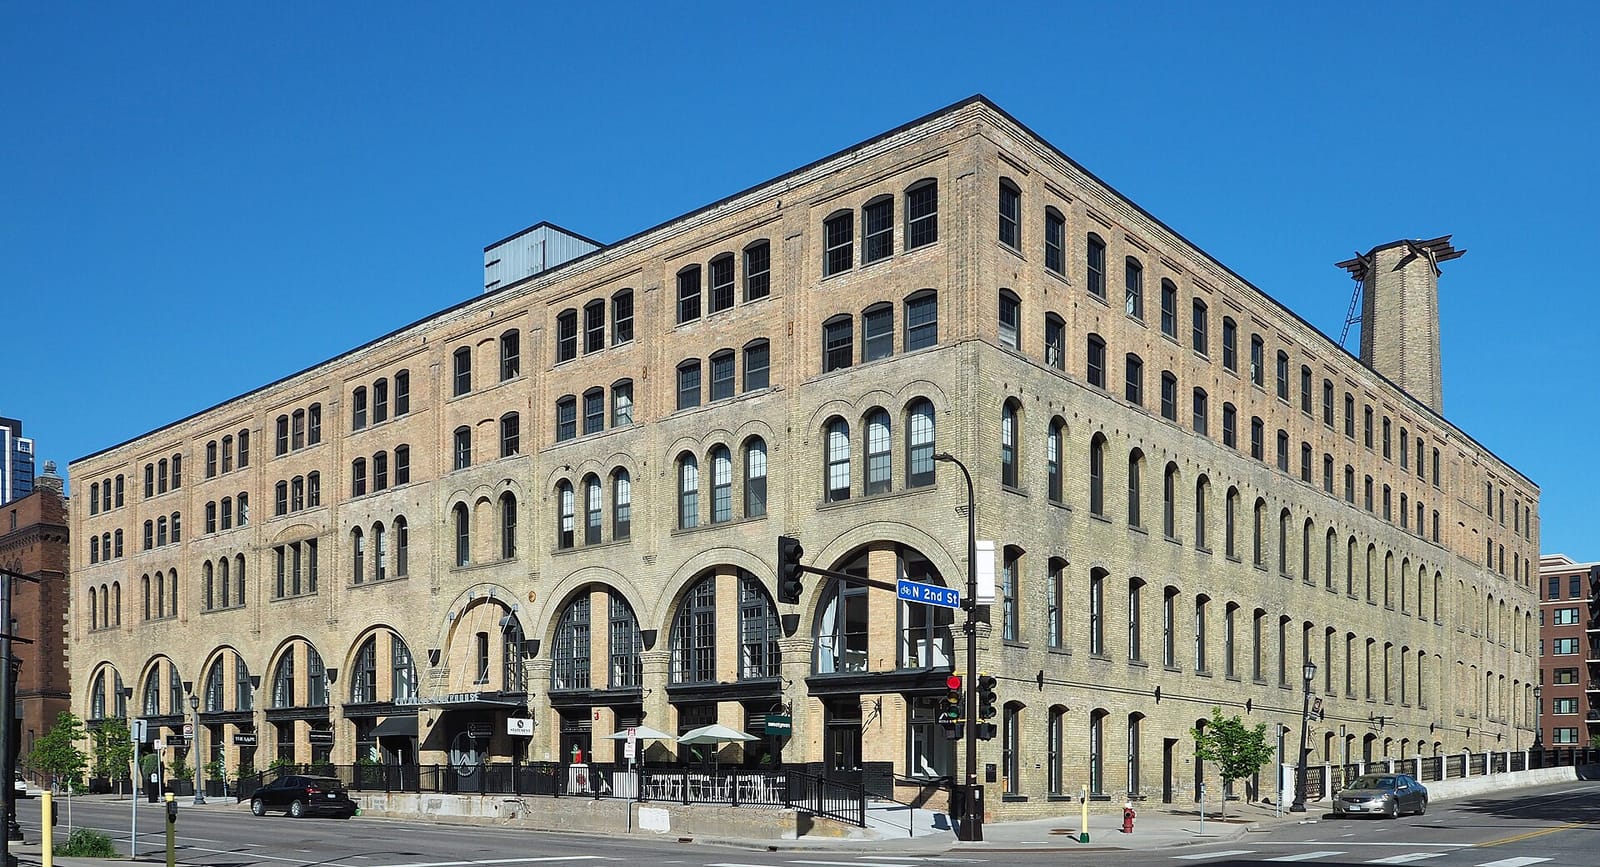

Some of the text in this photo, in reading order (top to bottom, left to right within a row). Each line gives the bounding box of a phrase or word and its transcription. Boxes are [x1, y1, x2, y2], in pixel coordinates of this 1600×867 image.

[912, 586, 958, 605] N 2nd St
